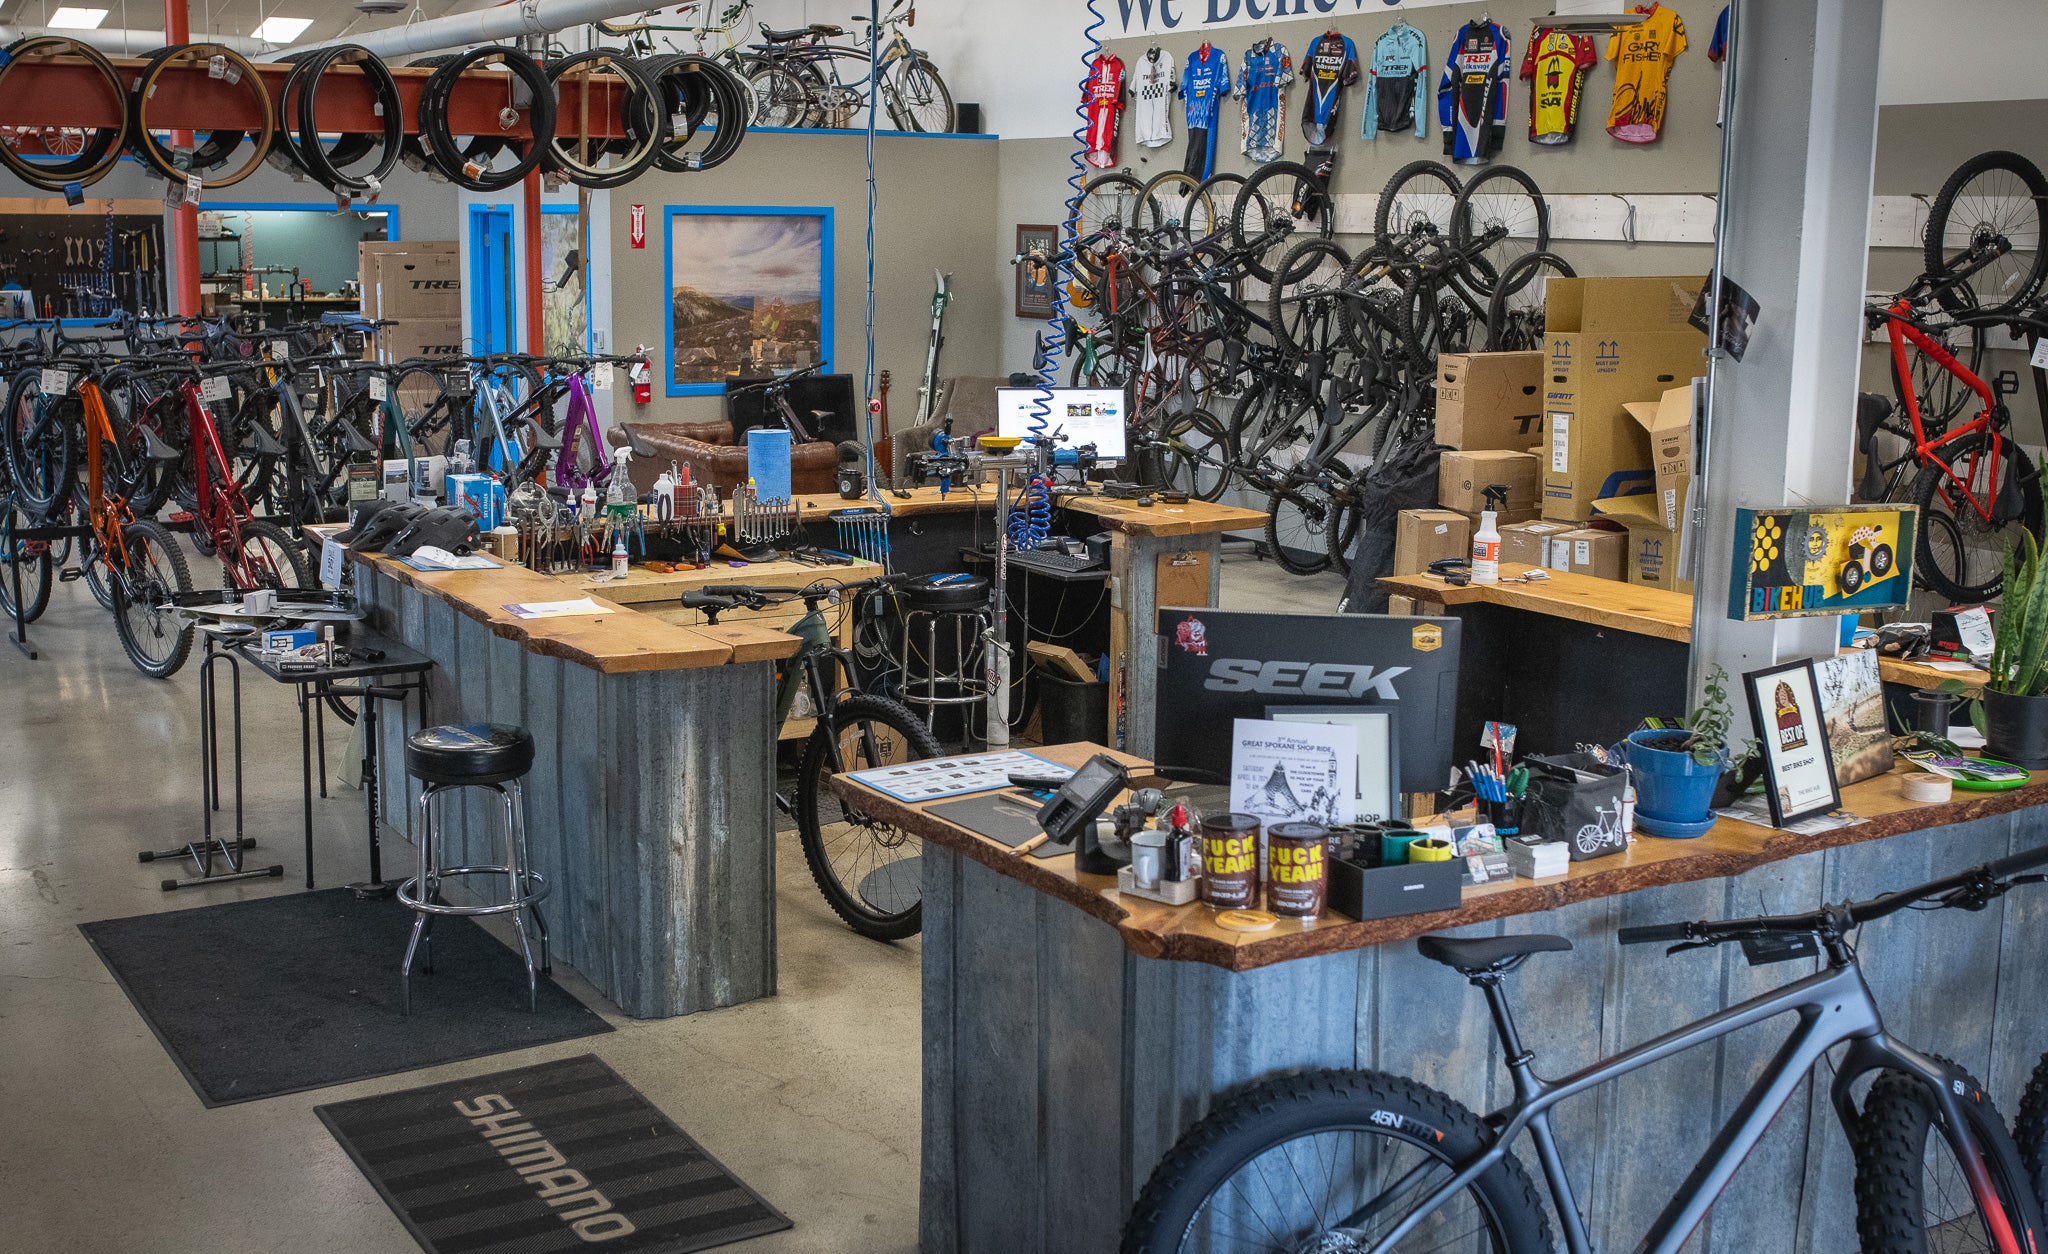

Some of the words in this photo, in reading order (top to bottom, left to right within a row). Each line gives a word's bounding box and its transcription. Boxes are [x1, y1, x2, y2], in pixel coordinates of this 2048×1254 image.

[1627, 41, 1660, 53] GARY
[1314, 55, 1343, 64] TREK
[1092, 85, 1116, 93] TREK
[409, 280, 461, 290] TRE
[419, 345, 463, 355] TRE
[1547, 392, 1575, 400] GIANT
[1752, 585, 1825, 612] BIKEHUB
[1203, 658, 1412, 700] SEEK
[1780, 727, 1795, 744] BEST
[1795, 724, 1805, 741] OF
[1241, 740, 1263, 748] GREAT
[1264, 741, 1295, 751] SPOKANE
[1297, 743, 1315, 752] SHOP
[1316, 745, 1331, 753] RIDE
[1781, 763, 1793, 773] BEST
[1793, 760, 1803, 770] BIKE
[1802, 757, 1815, 767] SHOP
[1355, 814, 1380, 823] HOP
[1495, 827, 1519, 835] MANO
[1203, 835, 1254, 856] FUCK
[1269, 844, 1322, 865] FUCK
[1203, 852, 1255, 874] YEAH!
[1269, 862, 1323, 883] YEAH!
[453, 1093, 636, 1242] SHIMANO
